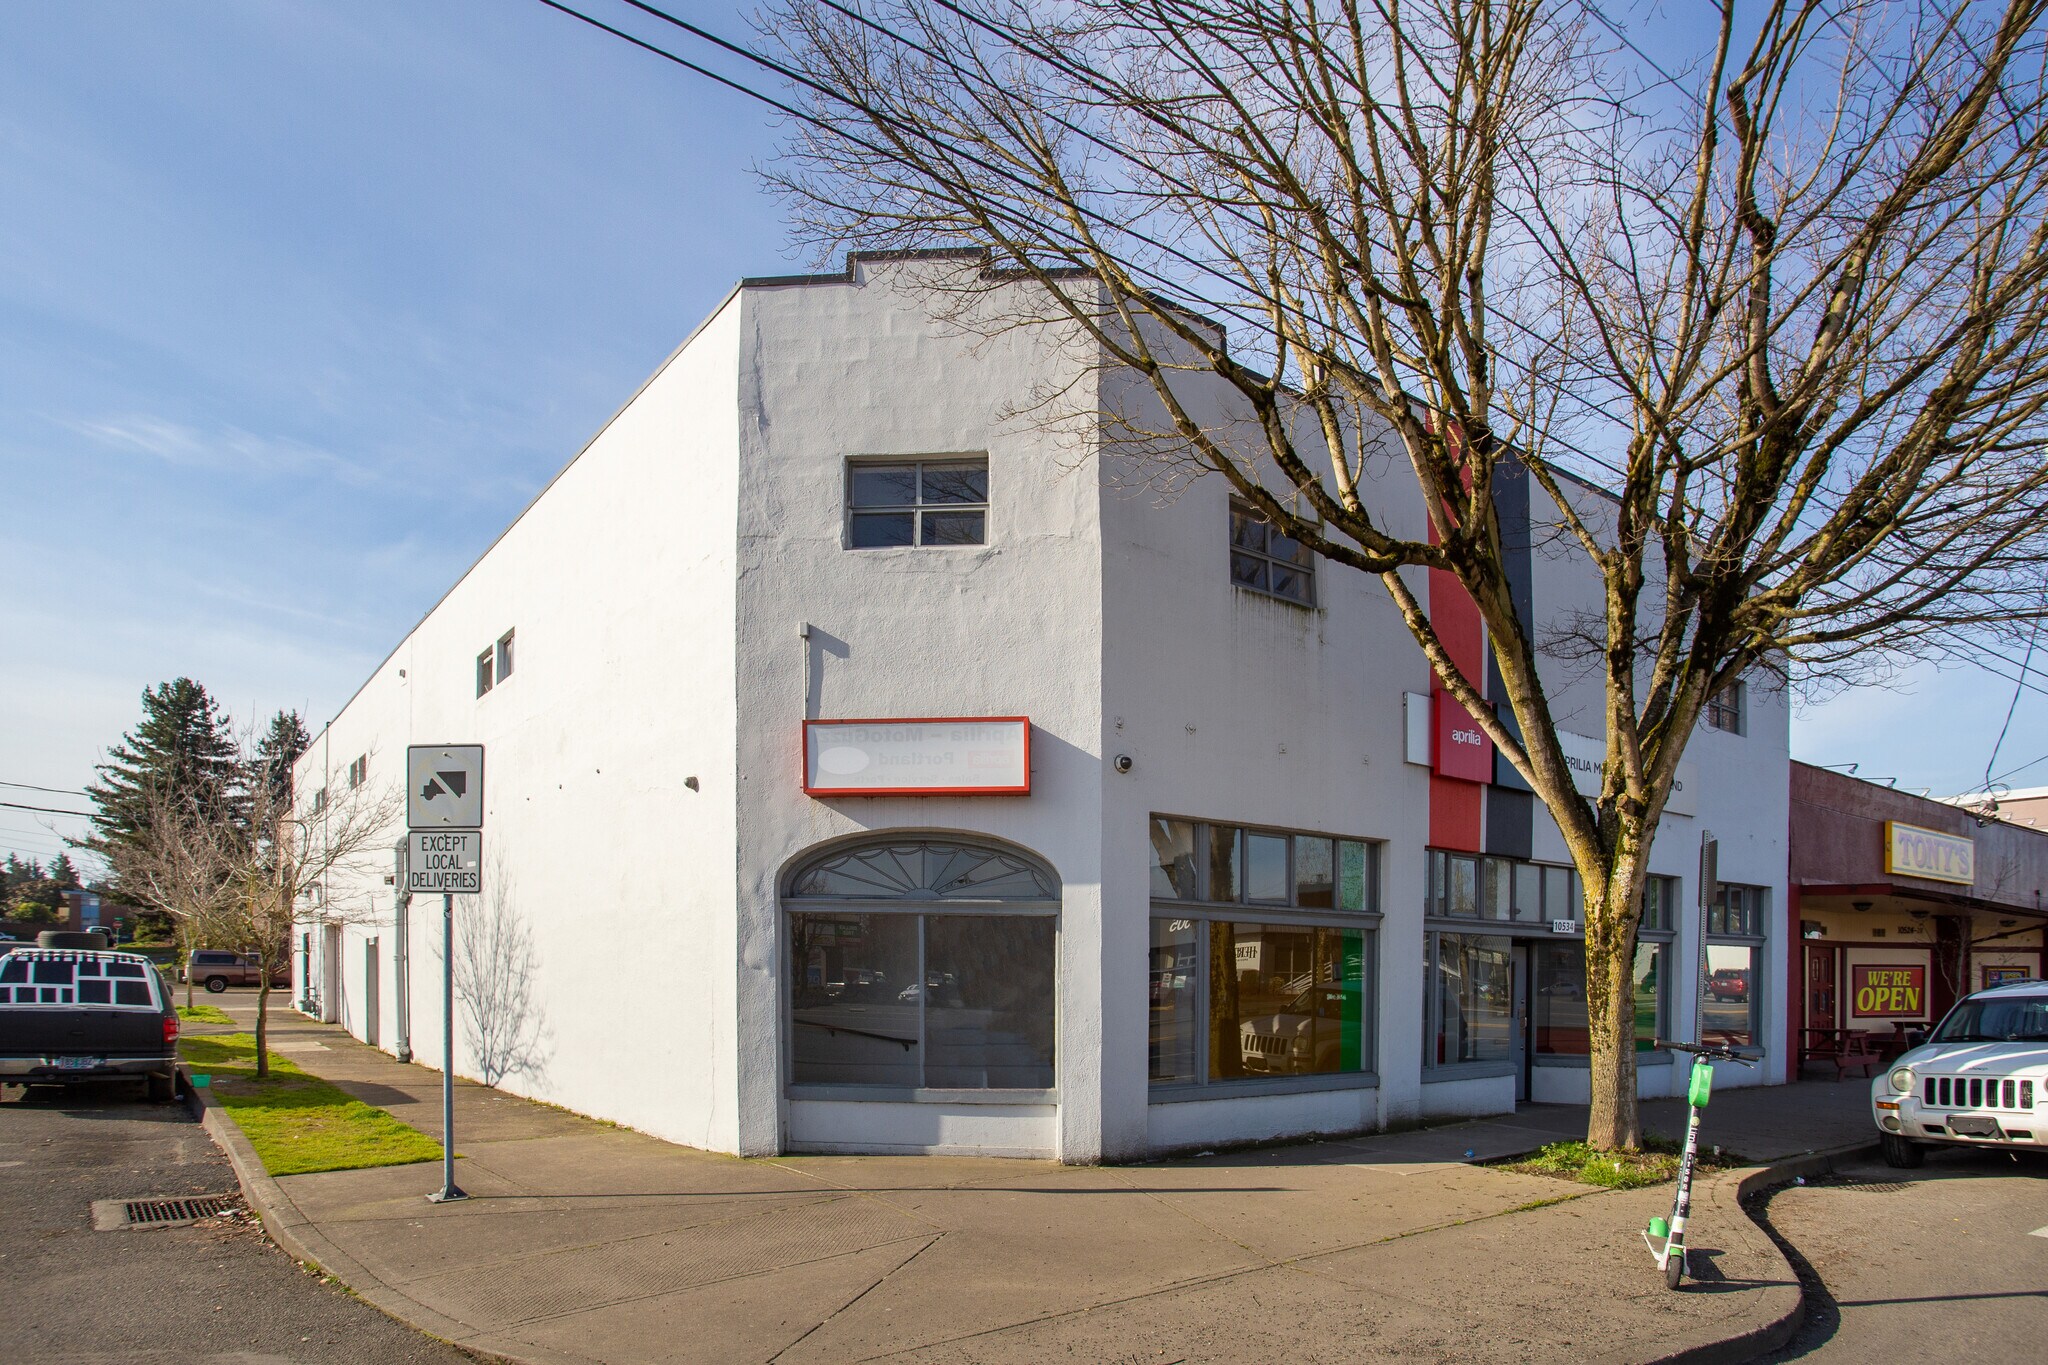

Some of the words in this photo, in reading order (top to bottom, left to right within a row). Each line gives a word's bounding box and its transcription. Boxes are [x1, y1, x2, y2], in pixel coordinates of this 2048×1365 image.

[1452, 729, 1481, 746] aprilia
[1565, 755, 1592, 773] PRILIA
[421, 836, 468, 852] EXCEPT
[426, 854, 463, 870] LOCAL
[1897, 834, 1970, 875] TONY'S
[411, 872, 477, 888] DELIVERIES
[1554, 921, 1574, 932] 10534
[1867, 970, 1912, 986] WE'RE
[1857, 987, 1920, 1012] OPEN
